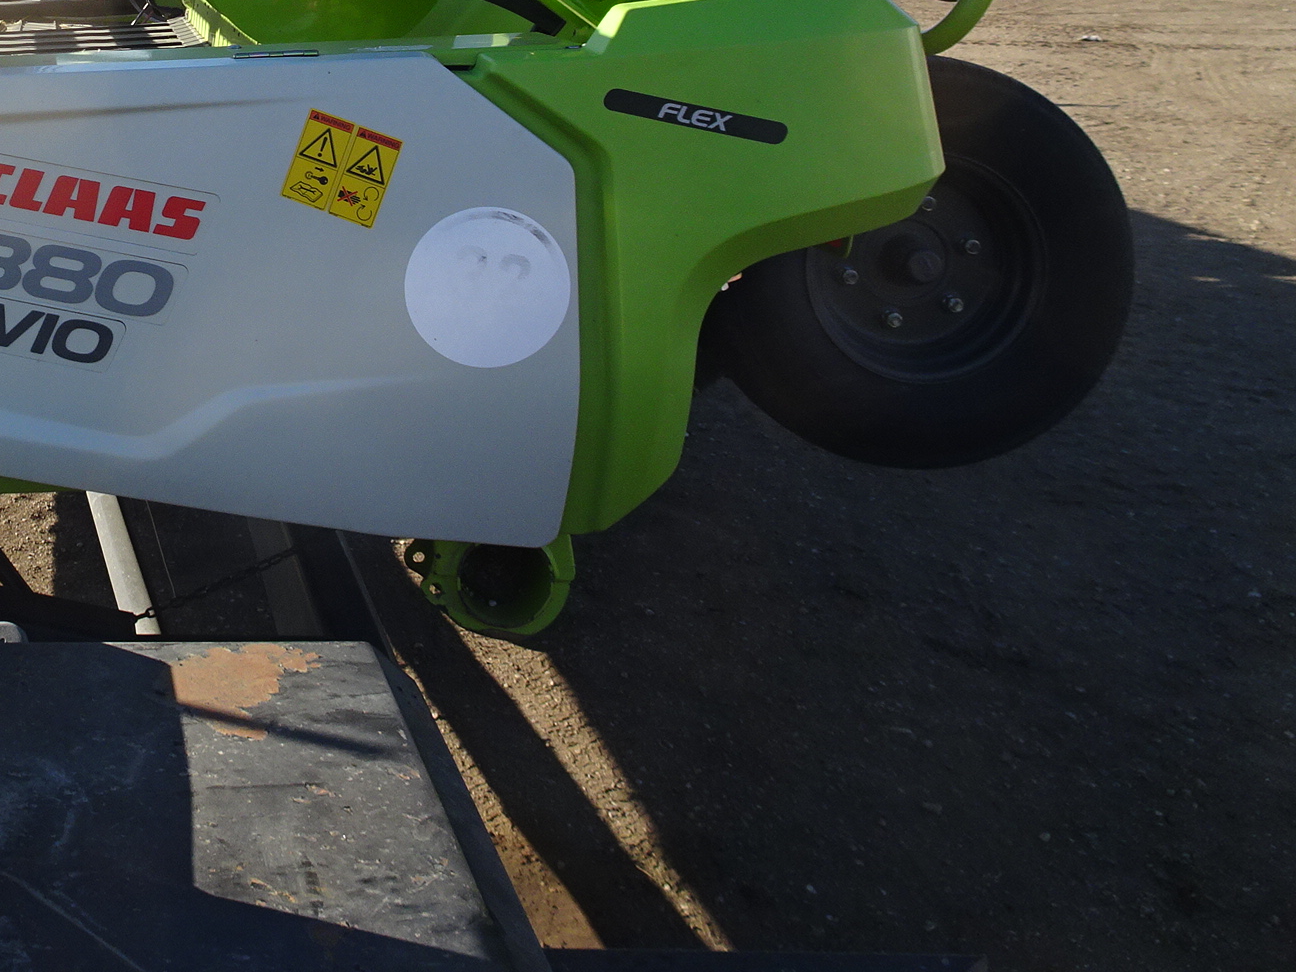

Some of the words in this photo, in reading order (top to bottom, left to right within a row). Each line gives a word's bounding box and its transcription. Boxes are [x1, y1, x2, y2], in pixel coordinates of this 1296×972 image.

[320, 115, 351, 131] WARNING
[657, 102, 733, 132] FLEX
[367, 133, 400, 149] WARNING
